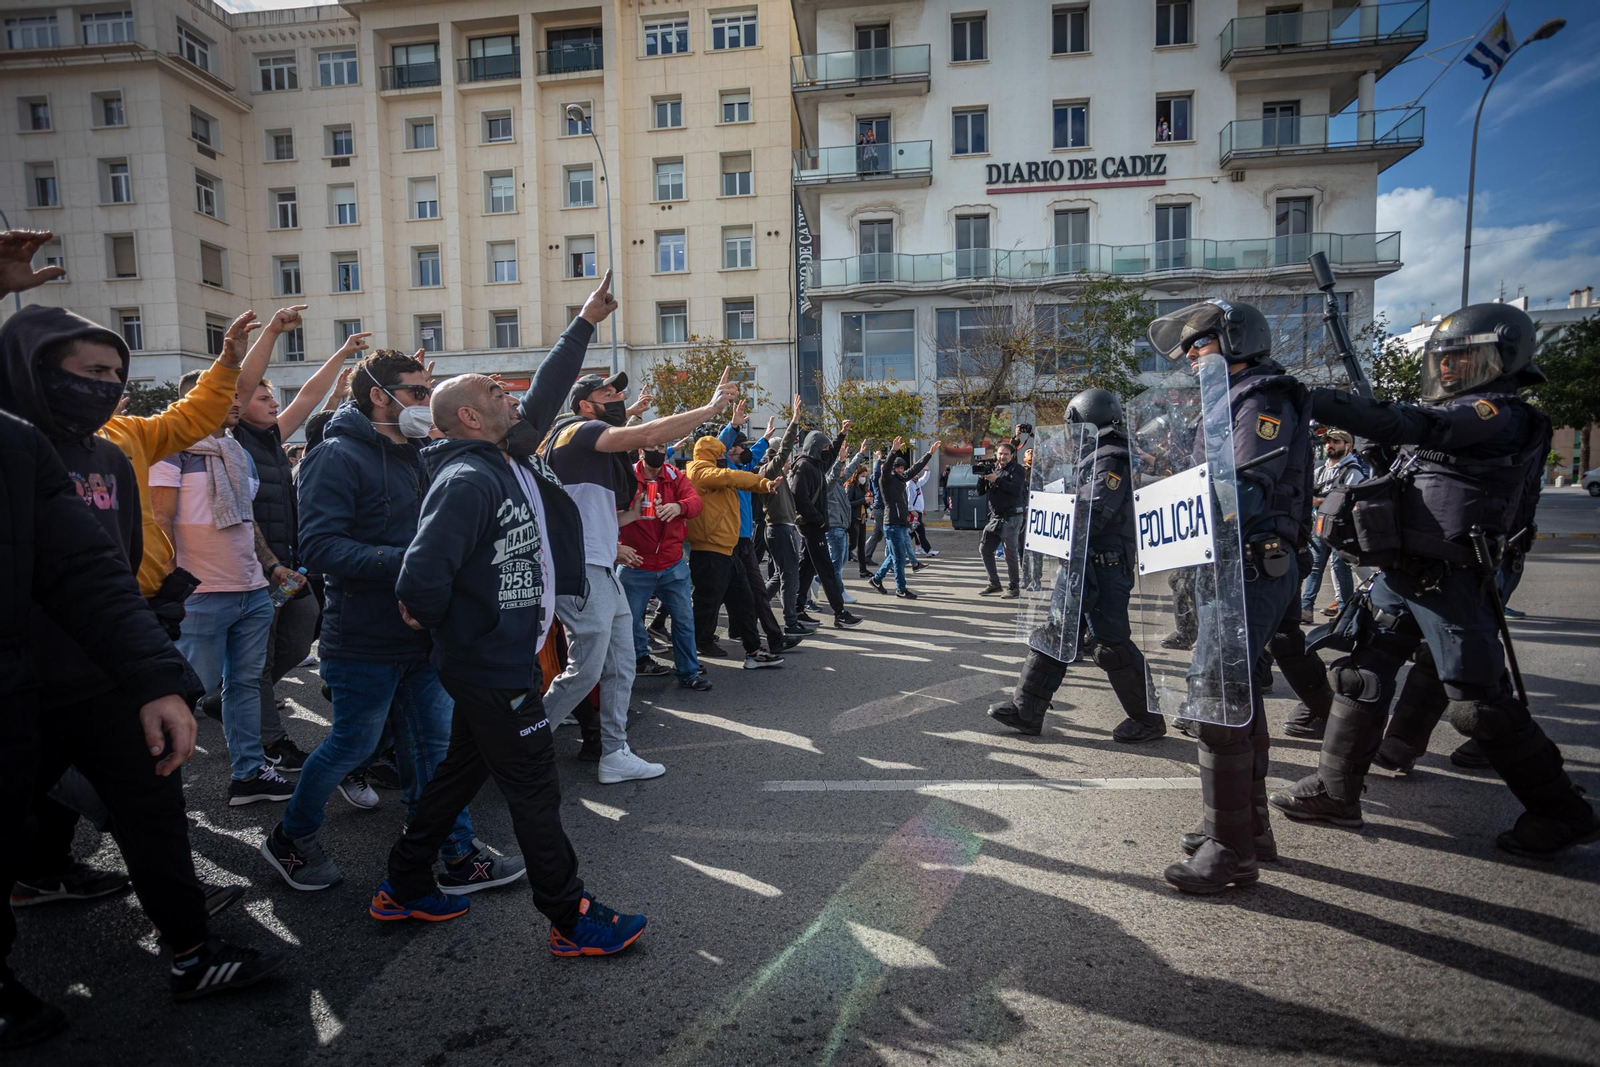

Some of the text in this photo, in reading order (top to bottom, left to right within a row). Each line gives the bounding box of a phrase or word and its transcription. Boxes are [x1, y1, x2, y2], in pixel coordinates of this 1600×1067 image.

[986, 154, 1167, 185] DIARIO DE CADIZ
[799, 246, 813, 264] DE
